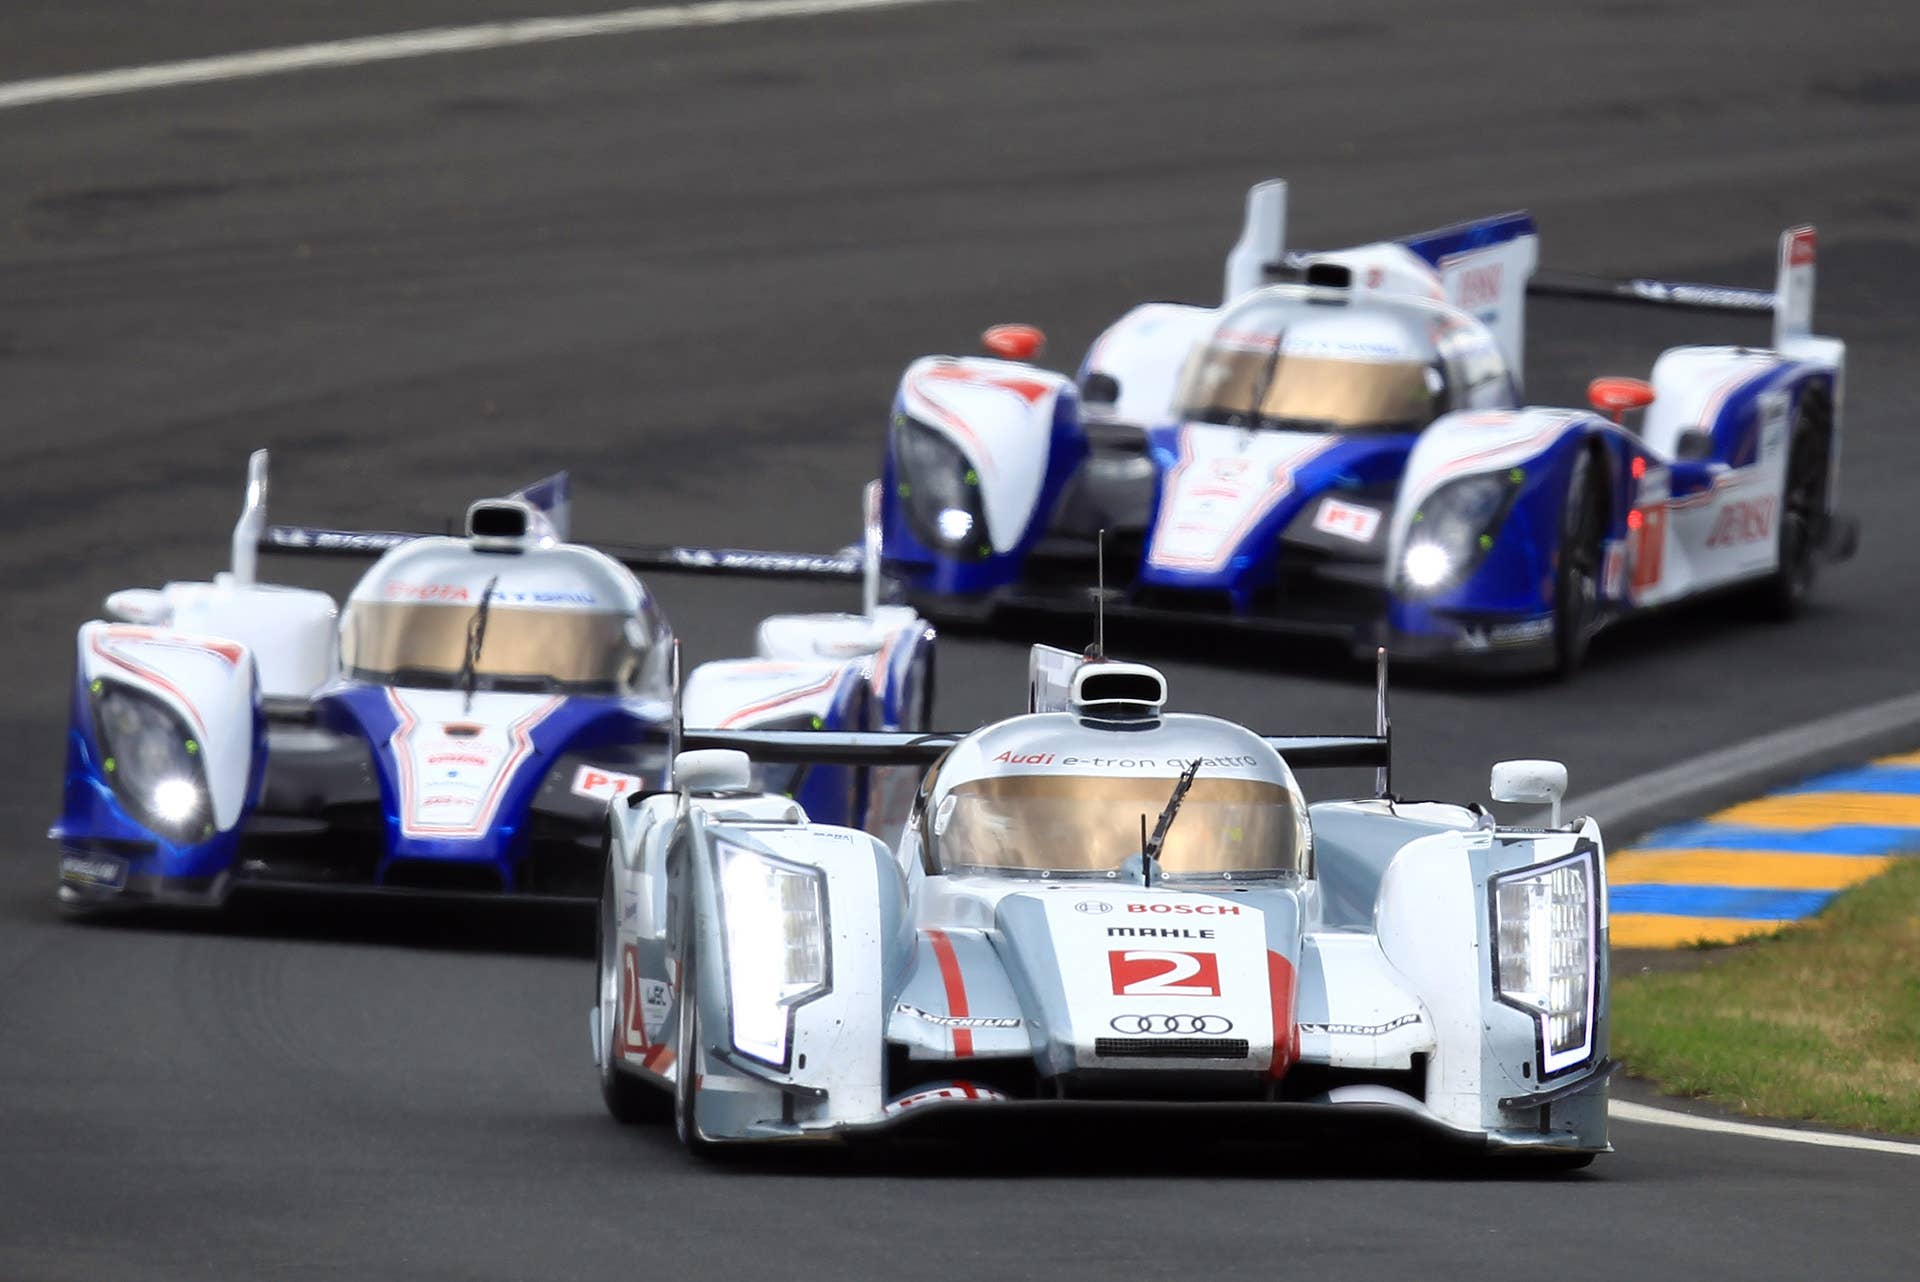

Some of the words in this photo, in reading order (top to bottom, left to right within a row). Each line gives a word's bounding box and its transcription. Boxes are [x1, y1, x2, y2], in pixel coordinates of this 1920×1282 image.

[992, 750, 1055, 765] Audi
[1061, 756, 1156, 769] e-tron
[583, 772, 628, 793] P1
[1126, 903, 1241, 916] BOSCH
[1106, 927, 1217, 940] MAHLE
[1123, 950, 1214, 996] 2
[922, 1011, 1018, 1028] MICHELIN
[1326, 1013, 1419, 1034] MICHELIN
